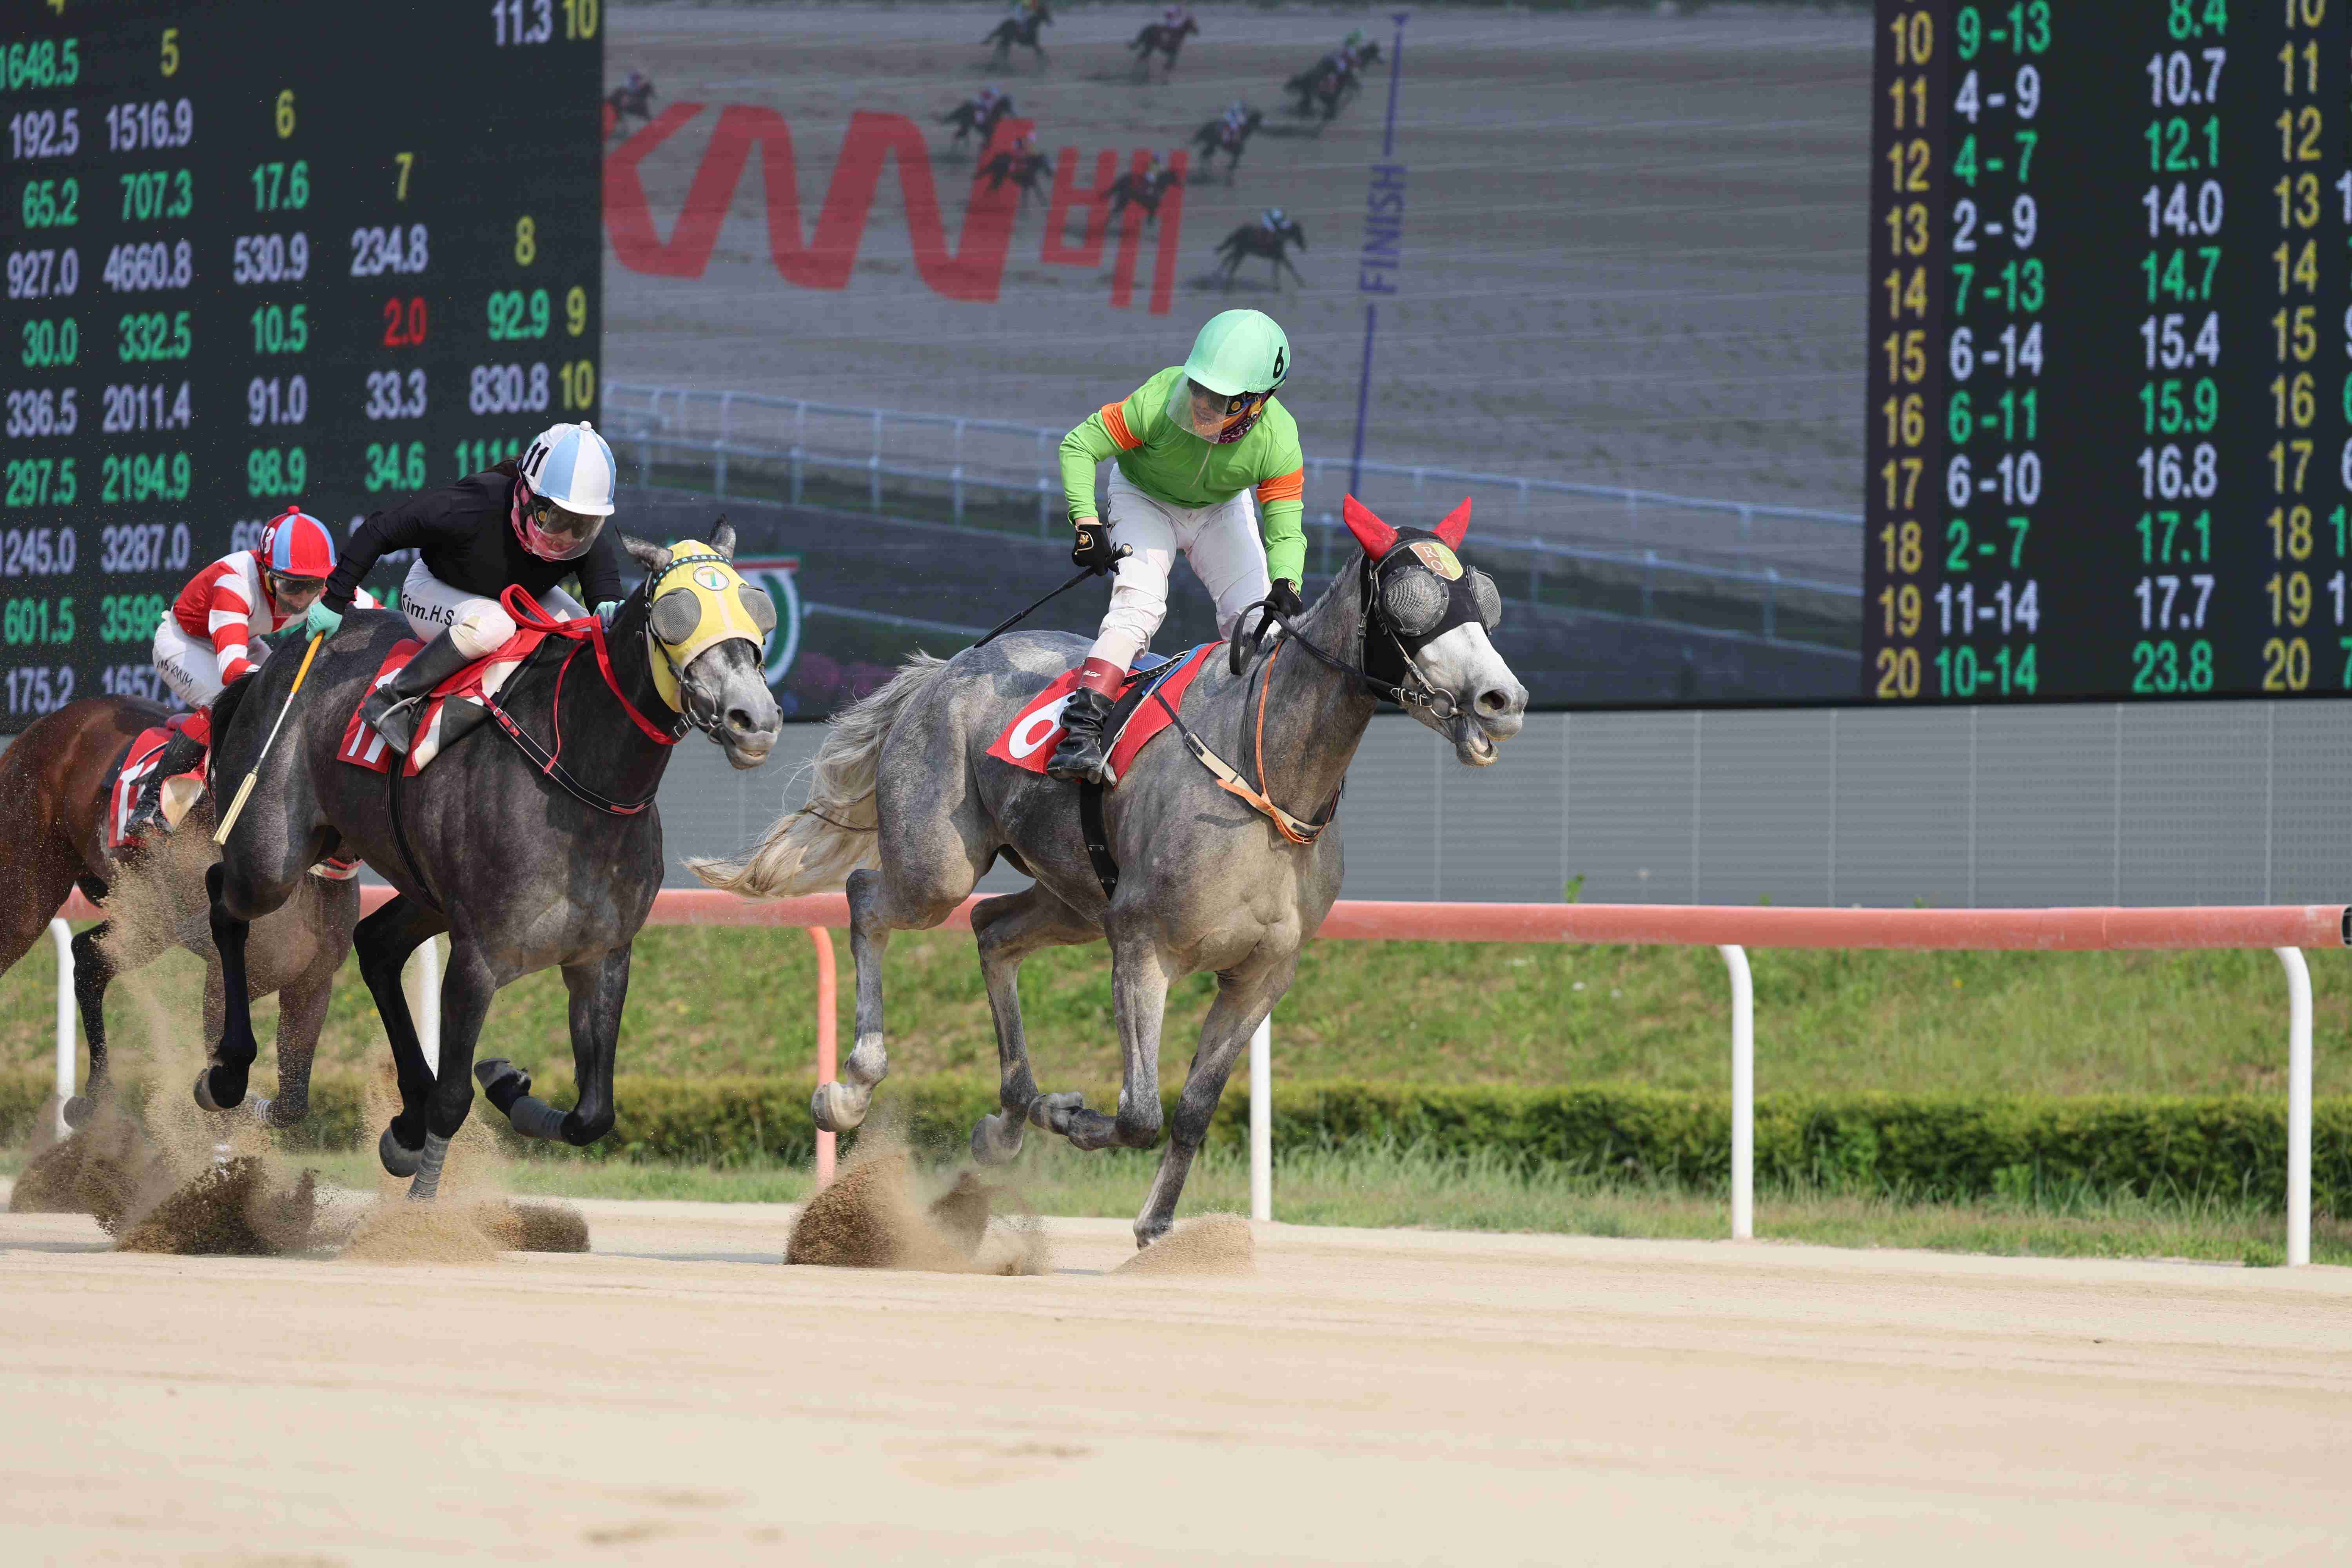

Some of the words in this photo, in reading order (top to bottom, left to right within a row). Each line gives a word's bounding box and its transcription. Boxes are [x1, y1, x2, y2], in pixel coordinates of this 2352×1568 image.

[160, 28, 180, 76] 5
[492, 0, 553, 45] 11.3
[562, 0, 598, 39] 10
[1890, 11, 1933, 64] 10
[2168, 0, 2228, 40] 8.4
[1889, 76, 1927, 128] 11
[2146, 47, 2227, 107] 10.7
[2279, 41, 2318, 94] 11
[9, 108, 80, 158] 192.5
[105, 98, 193, 151] 1516.9
[276, 89, 295, 138] 6
[1888, 139, 1930, 191] 12
[2144, 116, 2220, 171] 12.1
[2276, 106, 2322, 161] 12
[22, 178, 79, 227] 65.2
[120, 169, 193, 220] 707.3
[252, 160, 309, 209] 17.6
[395, 152, 414, 199] 7
[1886, 203, 1929, 255] 13
[2142, 180, 2224, 237] 14.0
[2274, 173, 2320, 227] 13
[7, 247, 80, 299] 927.0
[102, 240, 192, 292] 4660.8
[233, 232, 310, 284] 530.9
[350, 223, 429, 277] 234.8
[515, 216, 536, 265] 8
[1359, 164, 1407, 294] FINISH
[1884, 267, 1927, 318] 14
[2141, 246, 2221, 302] 14.7
[2273, 240, 2318, 294] 14
[22, 318, 78, 367] 30.0
[118, 311, 192, 362] 332.5
[251, 304, 308, 353] 10.5
[383, 297, 427, 347] 2.0
[487, 289, 550, 340] 92.9
[566, 286, 586, 336] 9
[1884, 330, 1926, 383] 15
[2140, 311, 2221, 369] 15.4
[2272, 306, 2317, 361] 15
[1273, 346, 1284, 379] 6
[5, 387, 78, 438] 336.5
[102, 382, 192, 433] 2011.4
[247, 375, 309, 426] 91.0
[365, 368, 428, 420] 33.3
[469, 362, 550, 415] 830.8
[559, 360, 595, 409] 10
[1883, 394, 1925, 446] 16
[2139, 377, 2218, 434] 15.9
[2270, 372, 2316, 428] 16
[5, 457, 77, 507] 297.5
[102, 452, 191, 502] 2194.9
[247, 447, 307, 497] 98.9
[365, 441, 426, 492] 34.6
[523, 441, 550, 477] 11
[1882, 457, 1924, 510] 17
[2137, 443, 2218, 499] 16.8
[2269, 439, 2314, 493] 17
[101, 522, 191, 573] 3287.0
[1880, 521, 1923, 573] 18
[2136, 510, 2210, 563] 17.1
[2267, 505, 2314, 560] 18
[3, 596, 76, 644] 601.5
[1878, 584, 1922, 637] 19
[2134, 574, 2216, 629] 17.7
[2266, 571, 2312, 626] 19
[5, 666, 75, 714] 175.2
[1876, 646, 1921, 698] 20
[2132, 639, 2214, 693] 23.8
[2262, 637, 2311, 690] 20
